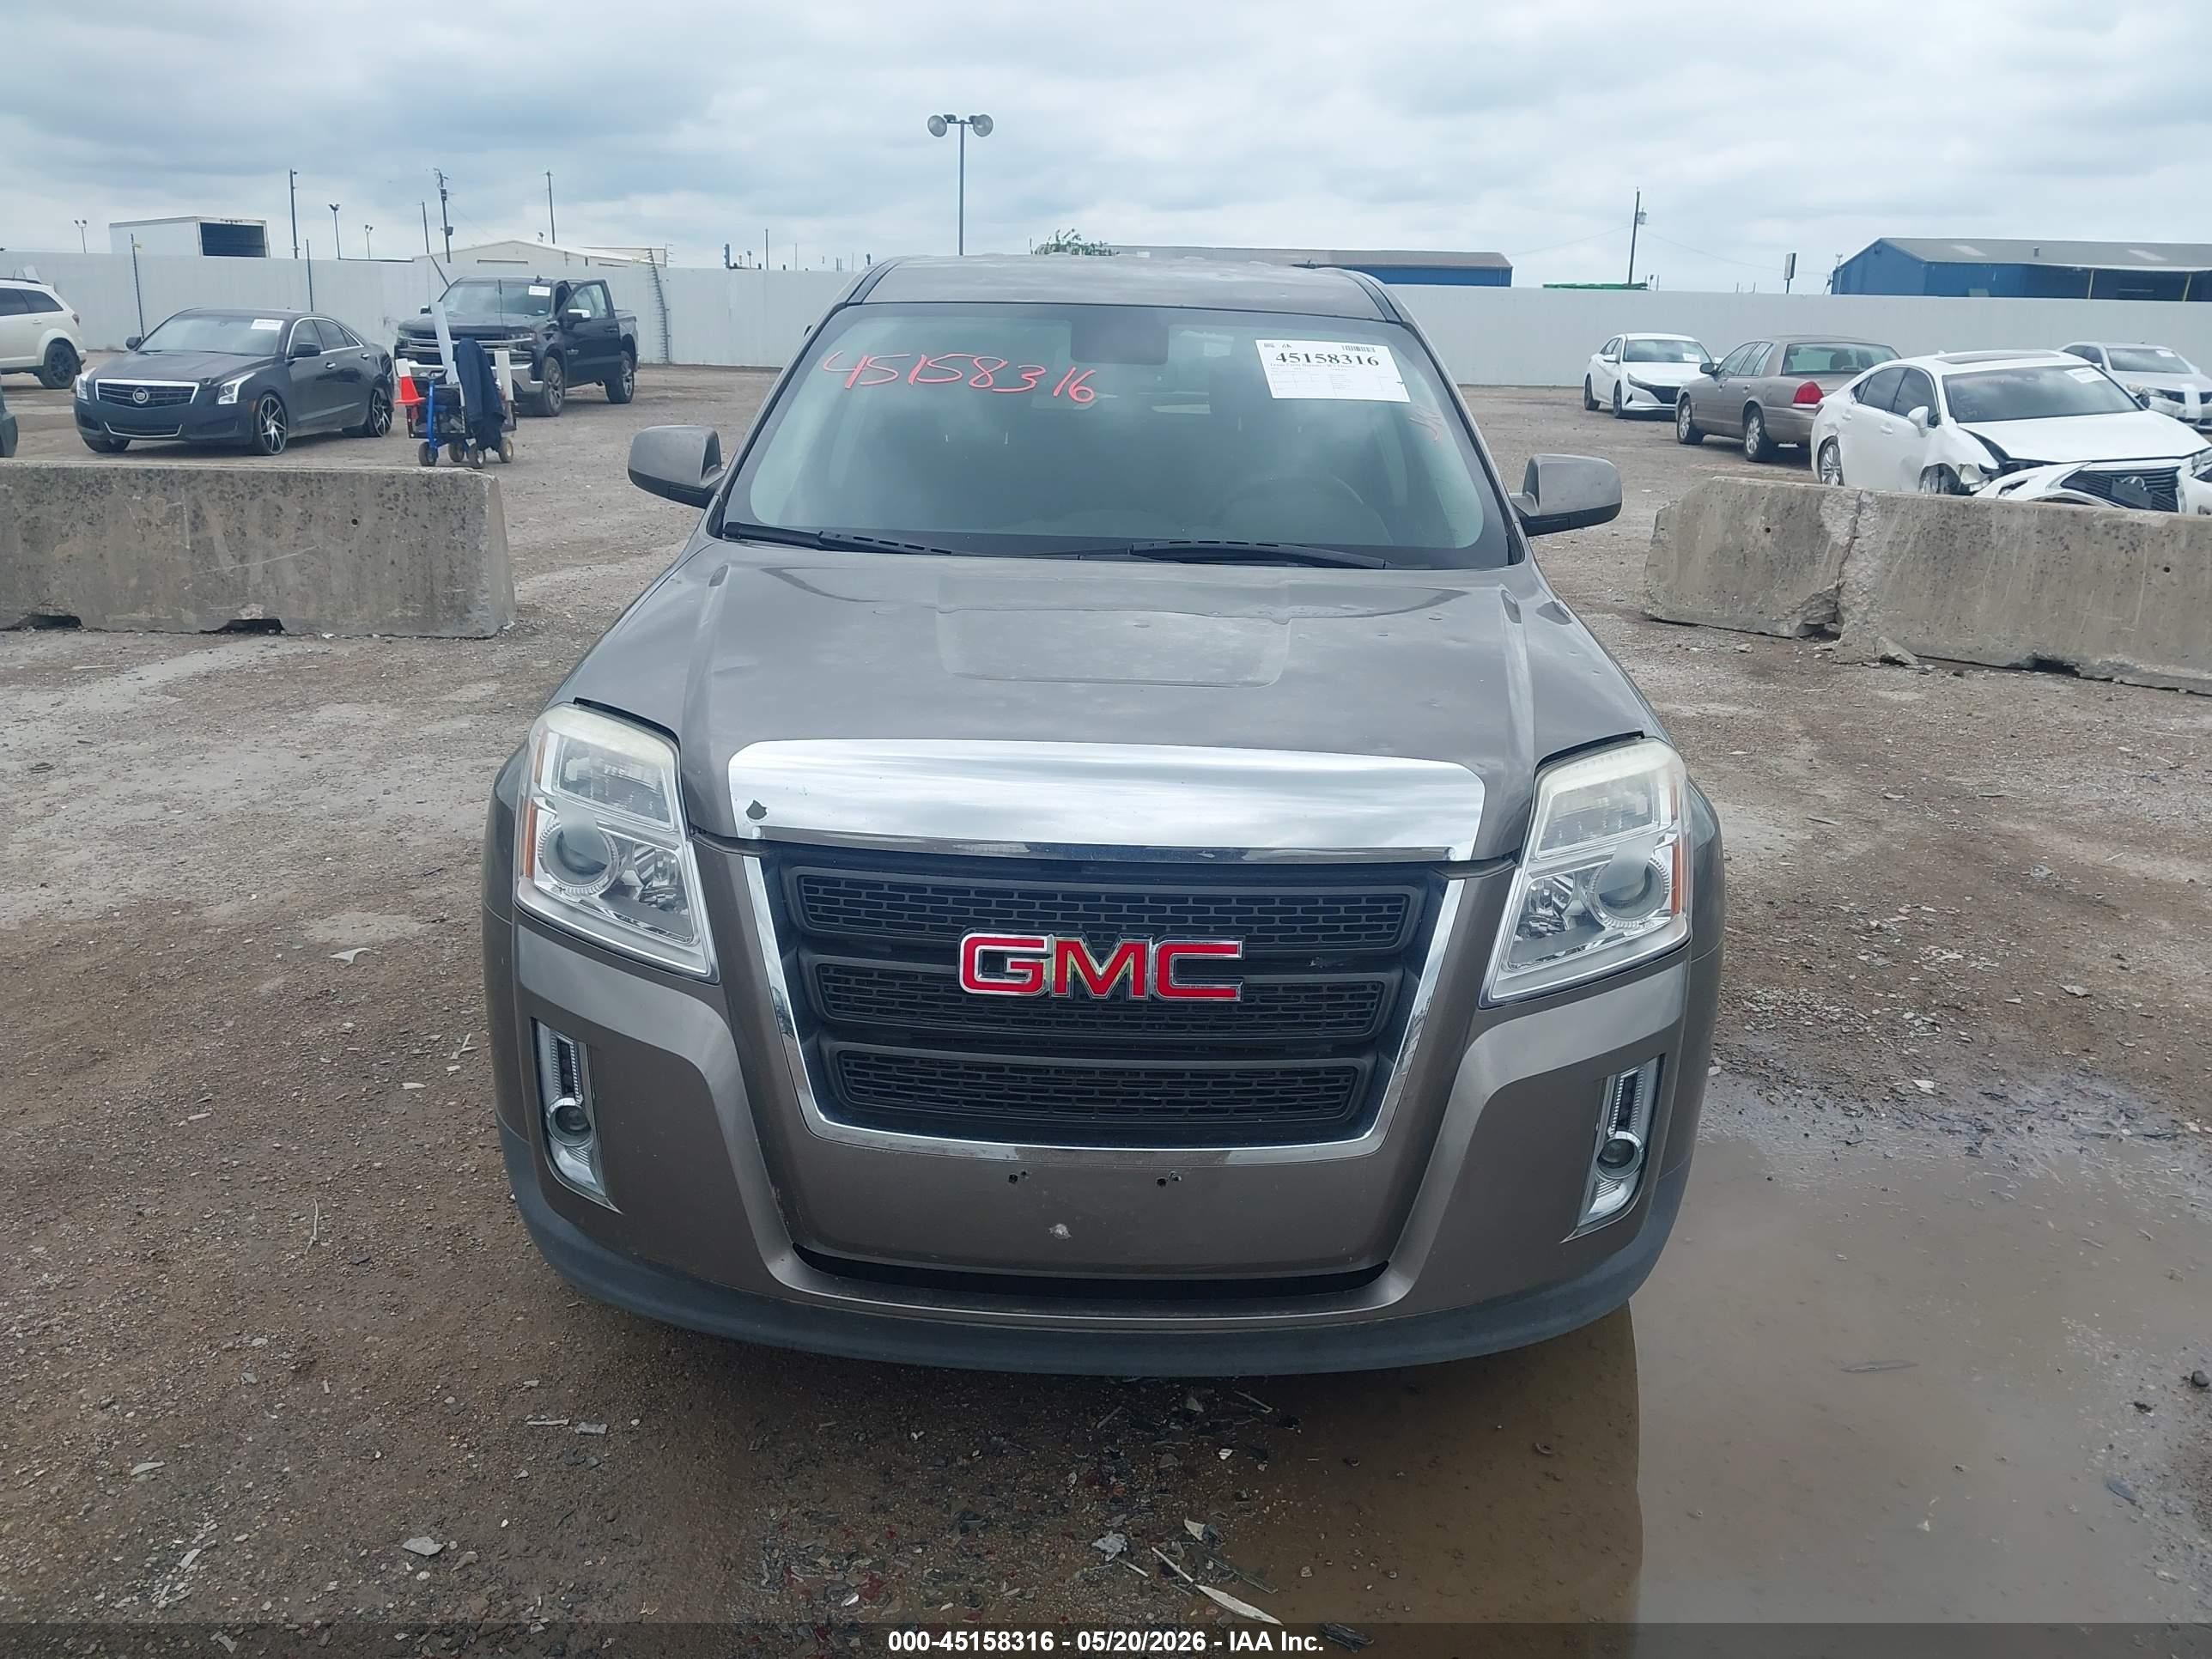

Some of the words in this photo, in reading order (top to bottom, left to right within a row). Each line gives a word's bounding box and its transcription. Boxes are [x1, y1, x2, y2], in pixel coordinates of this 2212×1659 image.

[823, 350, 1097, 403] 45158316
[1275, 351, 1380, 367] 45158316
[959, 932, 1243, 1001] GMC
